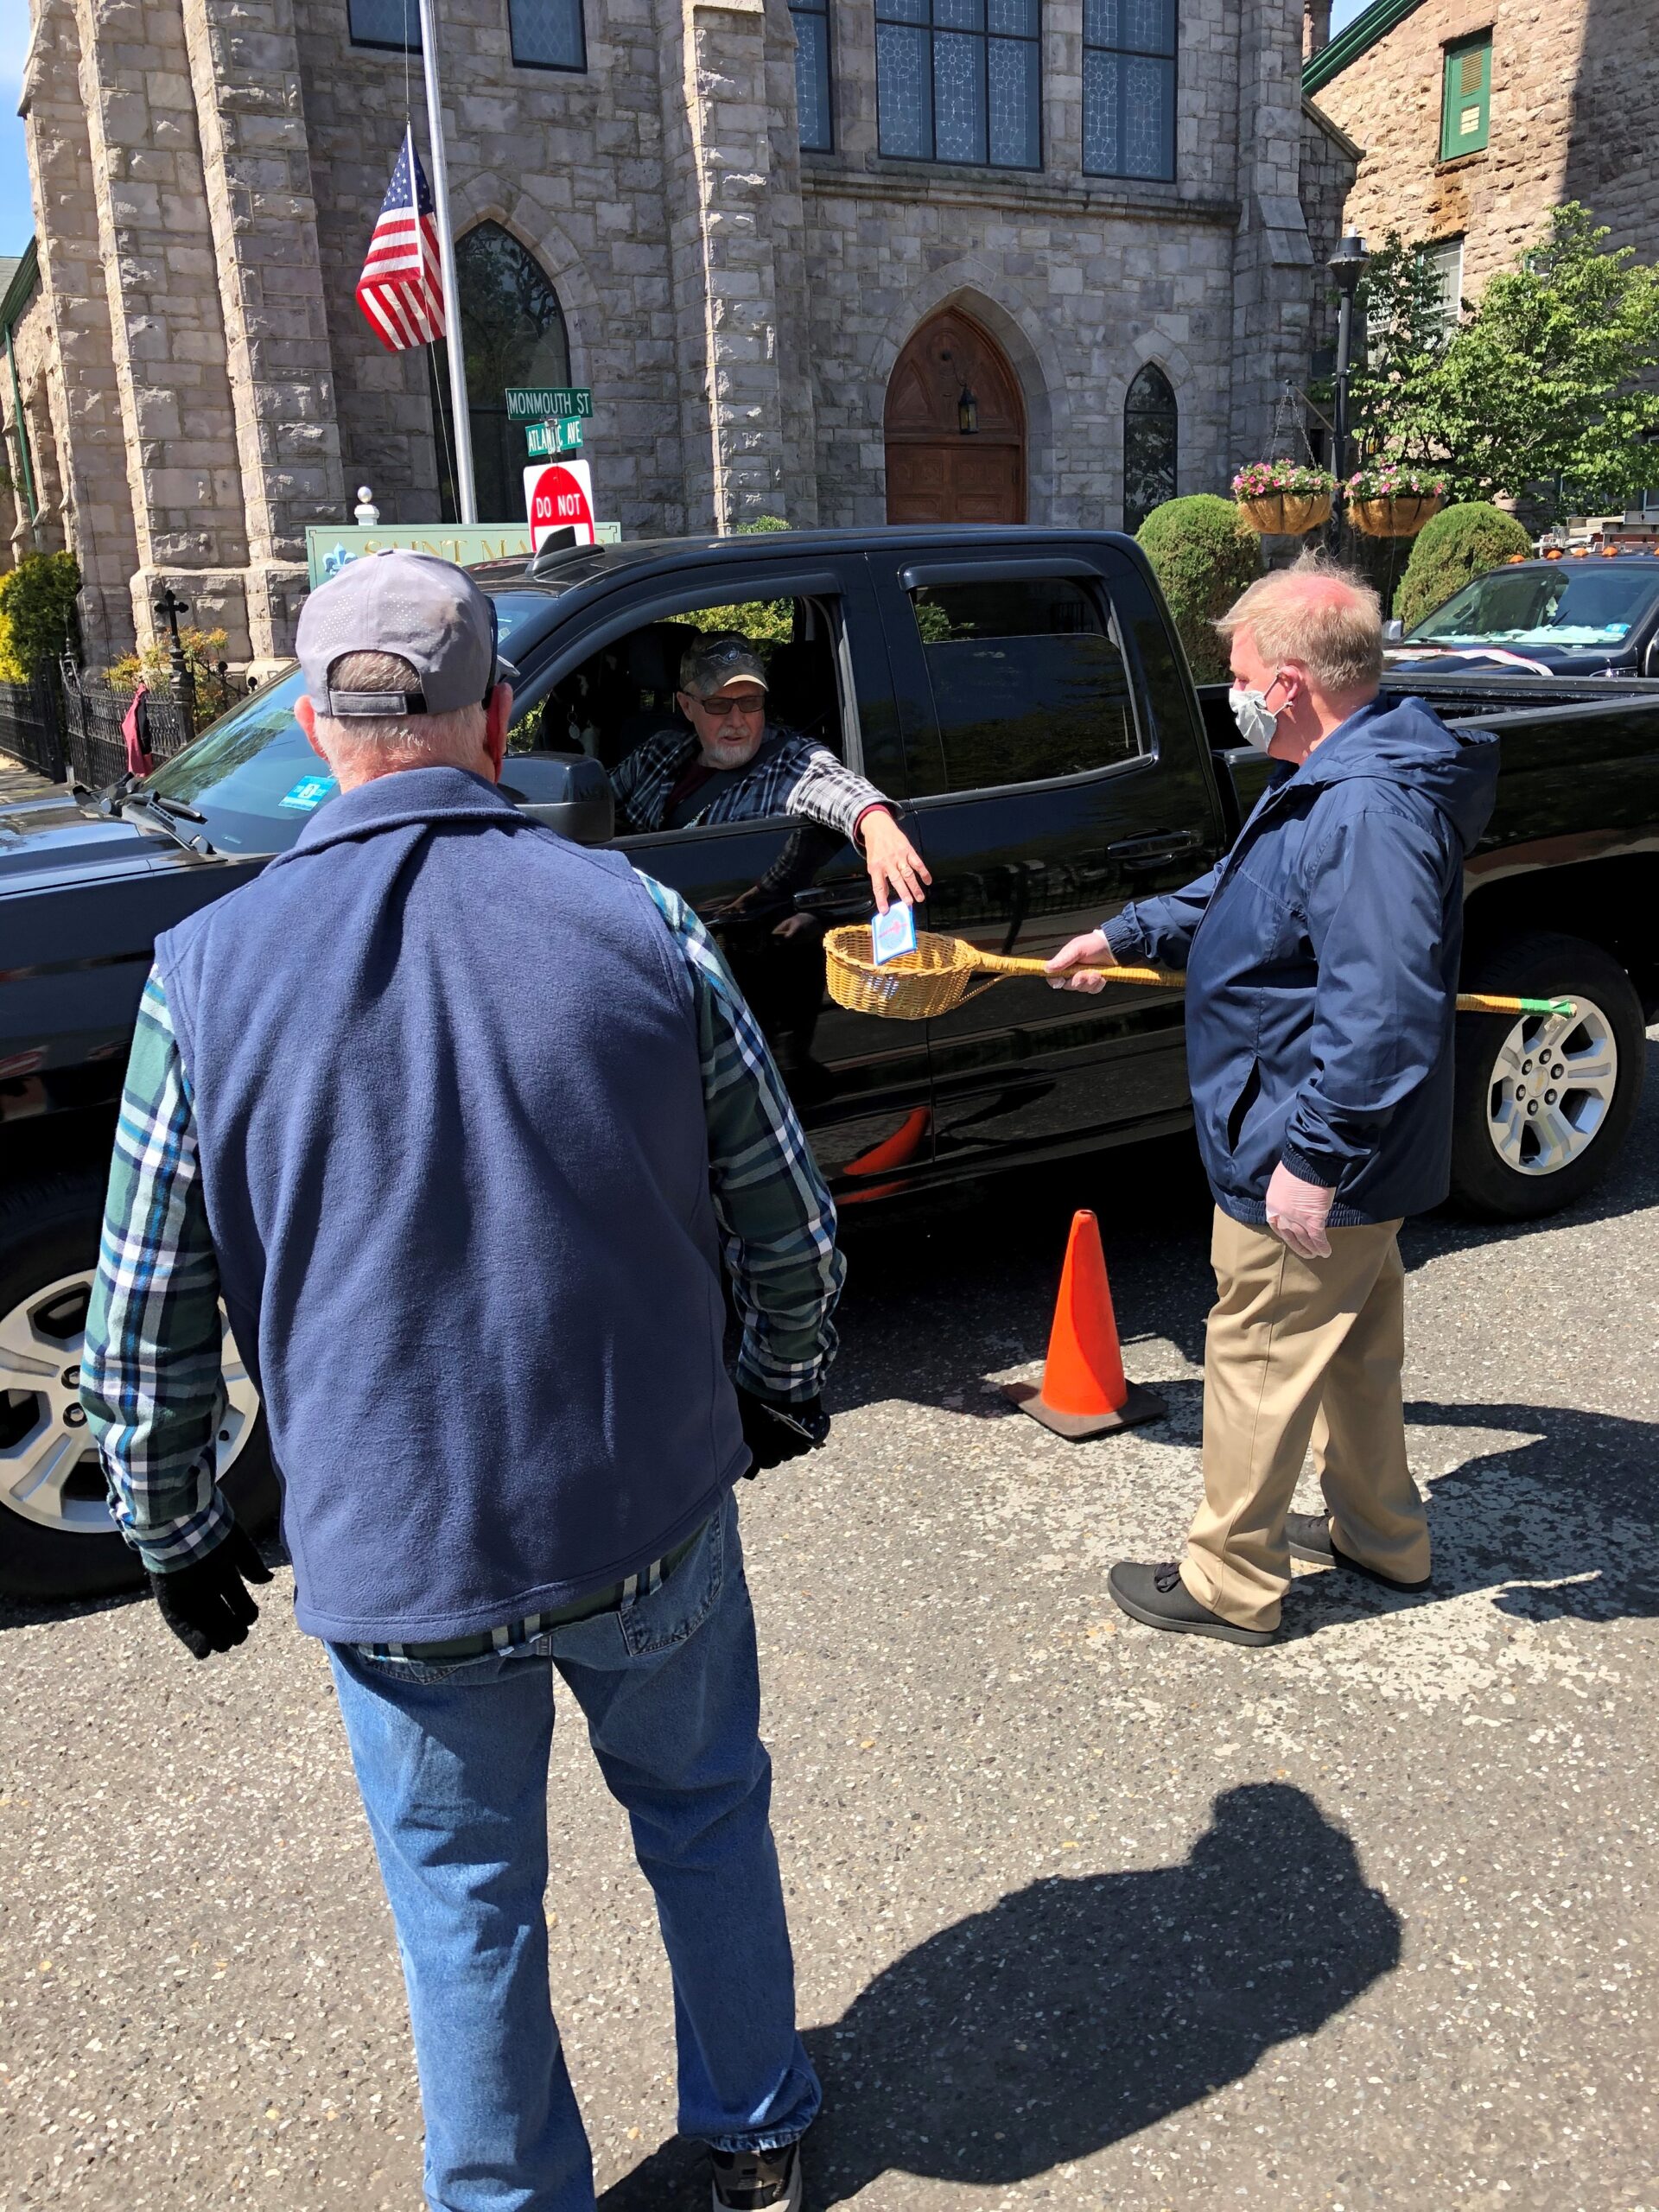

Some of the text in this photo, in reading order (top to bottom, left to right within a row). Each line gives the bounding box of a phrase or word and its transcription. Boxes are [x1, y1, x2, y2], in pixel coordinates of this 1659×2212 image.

[508, 392, 589, 414] MONMOUTH ST
[528, 421, 582, 452] ATLANIC AVE
[536, 493, 581, 518] DO NOT
